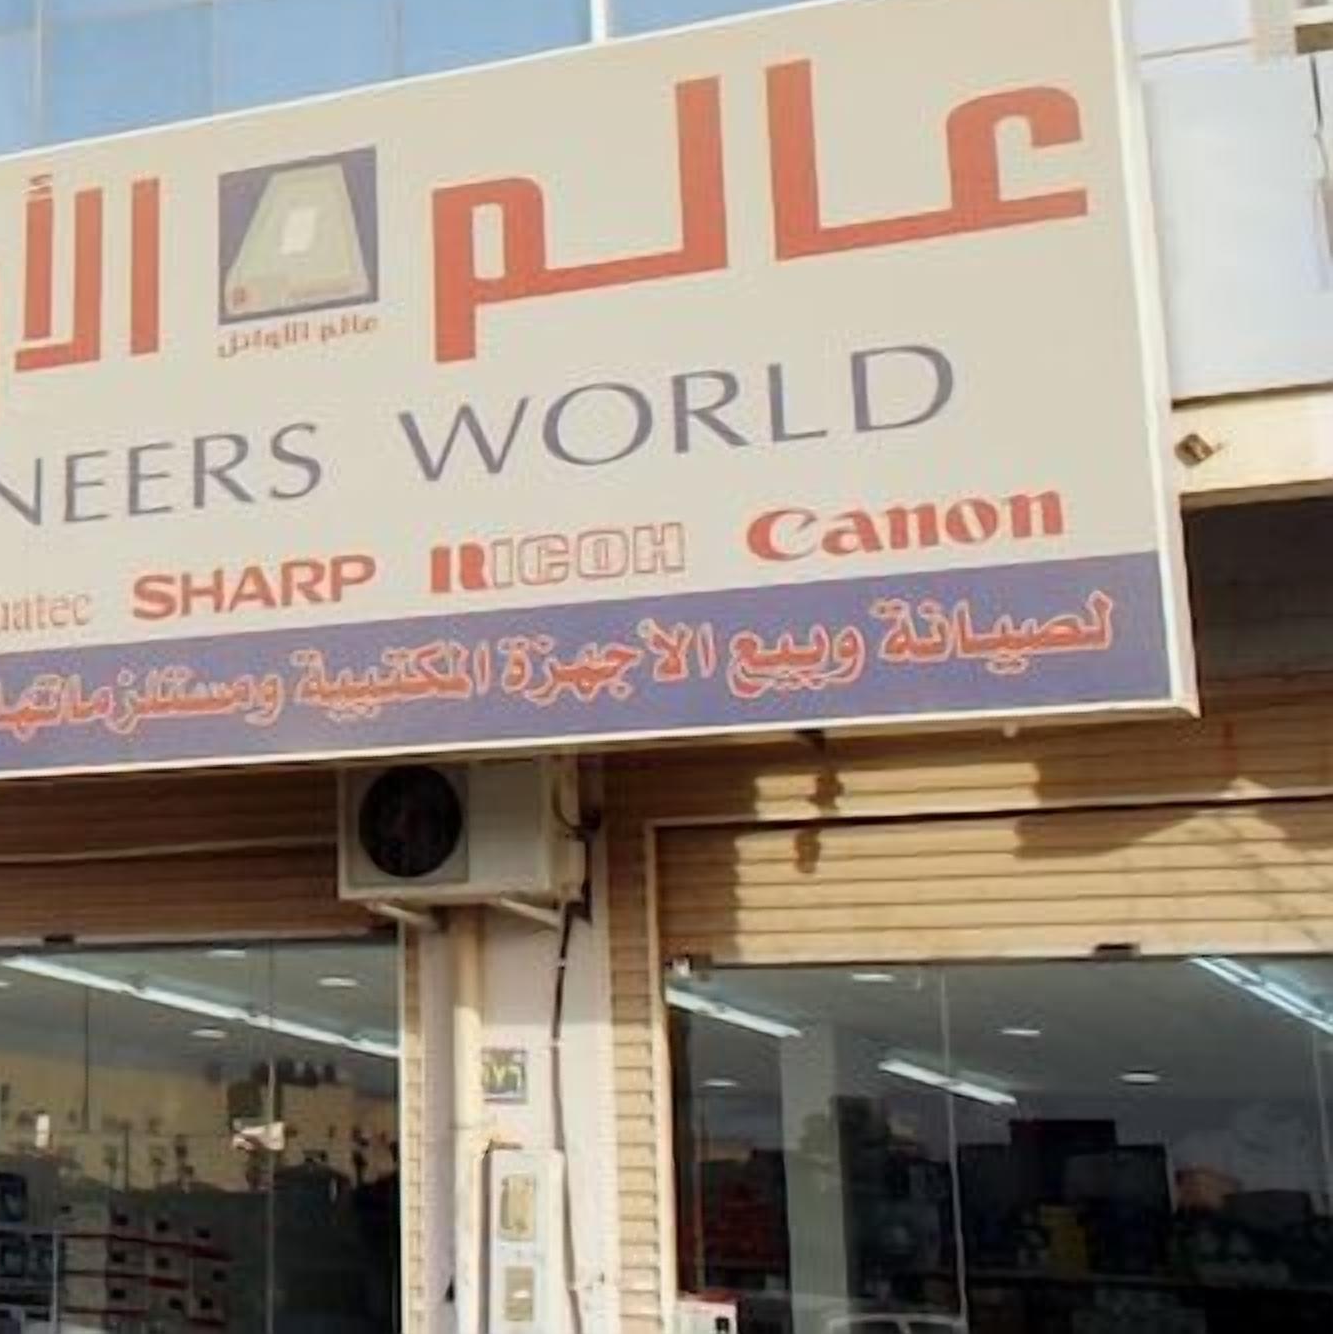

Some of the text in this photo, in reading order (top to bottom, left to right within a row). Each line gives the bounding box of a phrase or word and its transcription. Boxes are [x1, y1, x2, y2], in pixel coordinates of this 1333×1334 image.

[432, 59, 1090, 364] عالم
[397, 342, 956, 483] WORLD
[131, 553, 379, 621] SHARP
[428, 521, 688, 595] RICOH
[745, 488, 1066, 564] Canon
[289, 639, 491, 723] المكتبية
[727, 620, 867, 702] وبيع
[878, 588, 1116, 678] لصيانة
